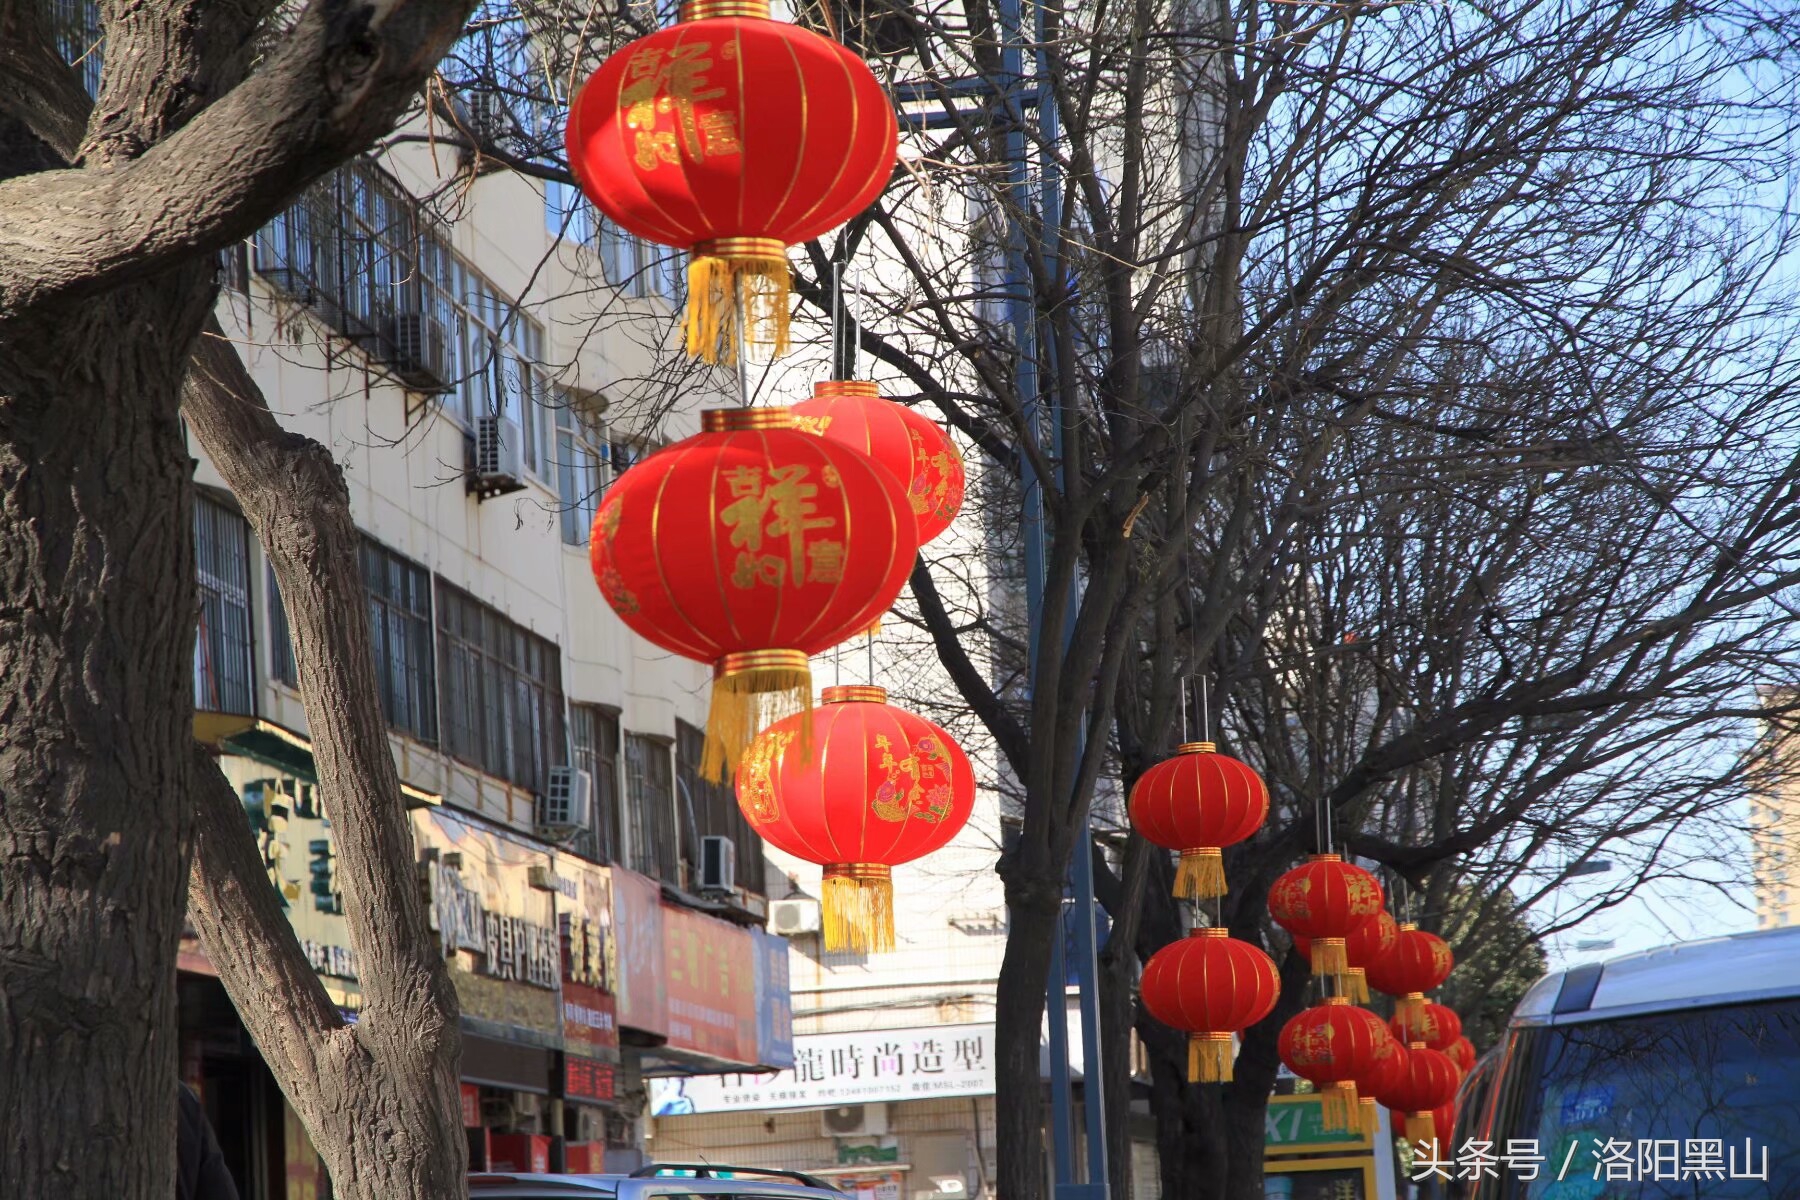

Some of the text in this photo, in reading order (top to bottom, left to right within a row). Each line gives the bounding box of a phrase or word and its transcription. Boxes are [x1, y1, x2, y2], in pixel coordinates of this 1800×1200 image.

[620, 41, 743, 171] 吉祥如意
[720, 464, 845, 589] 吉祥如意
[719, 1035, 986, 1088] 龍時尚造型
